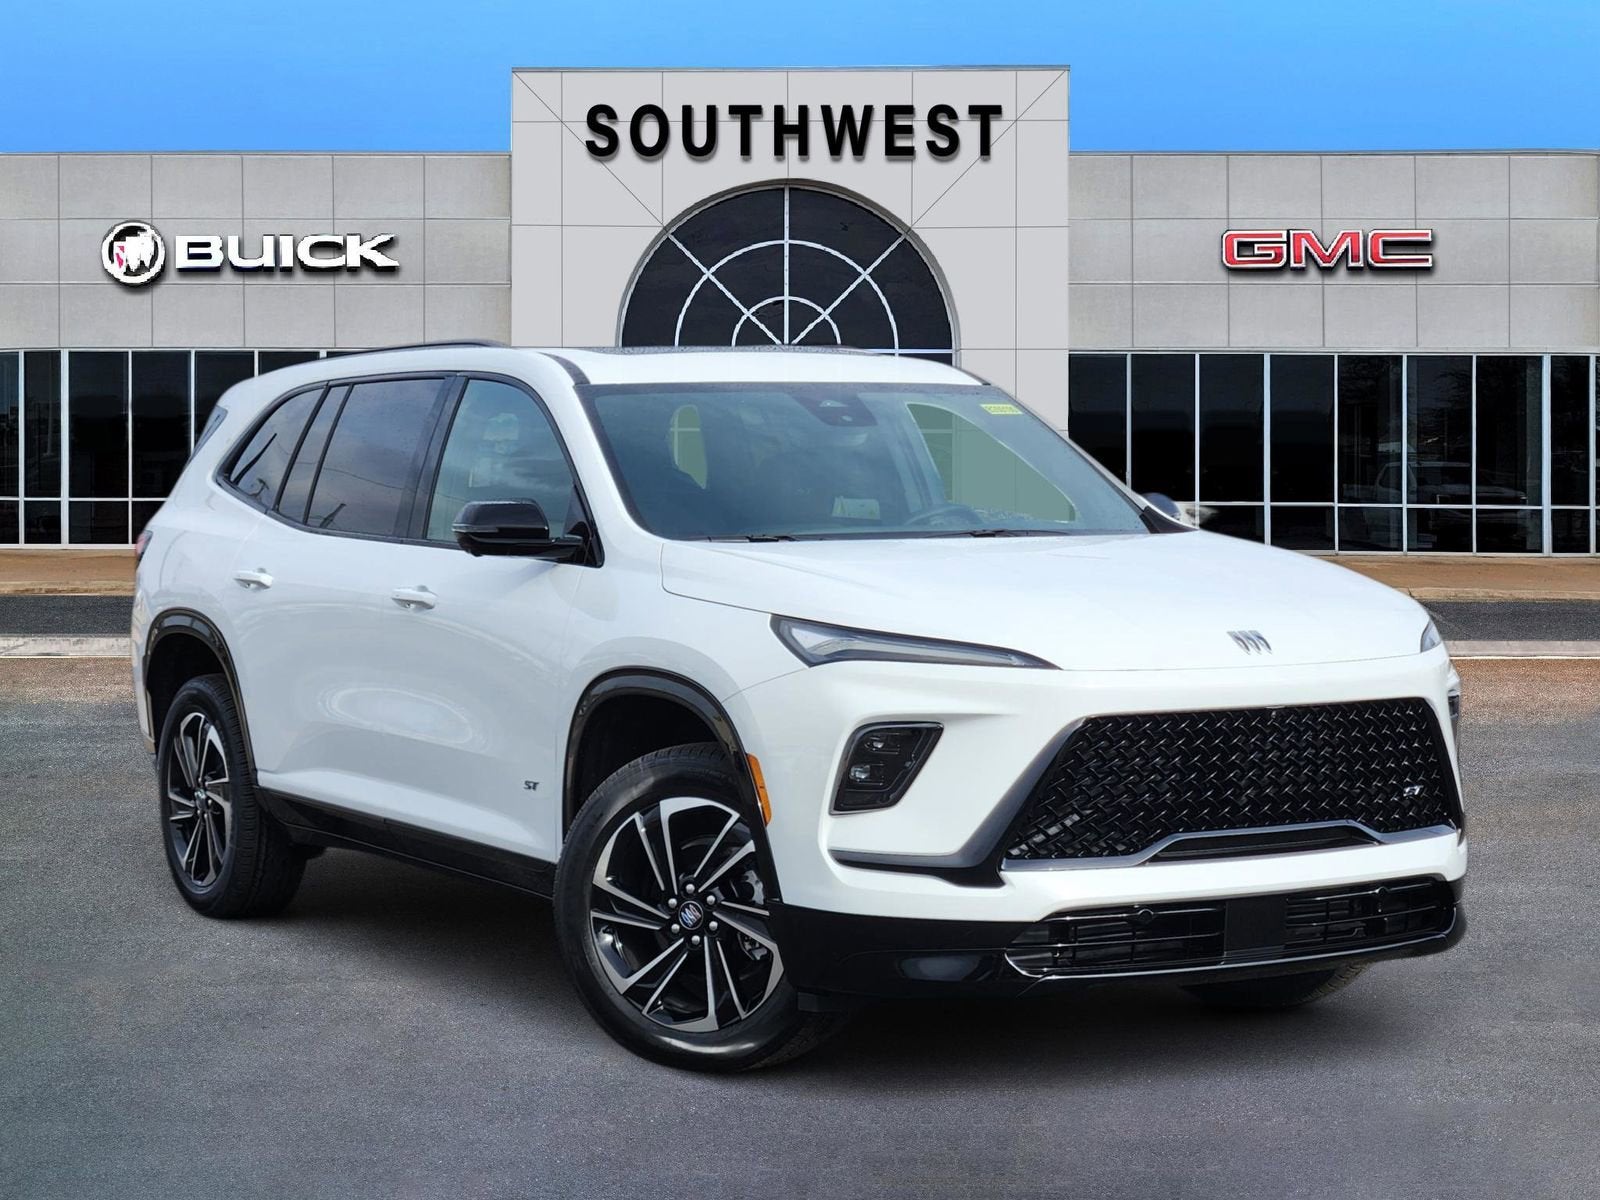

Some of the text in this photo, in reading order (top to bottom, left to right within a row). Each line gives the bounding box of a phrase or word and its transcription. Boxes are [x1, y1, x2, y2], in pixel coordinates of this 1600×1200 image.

[585, 104, 1003, 158] SOUTHWEST
[175, 234, 400, 271] BUICK
[1221, 229, 1433, 269] GMC
[523, 780, 540, 791] ST
